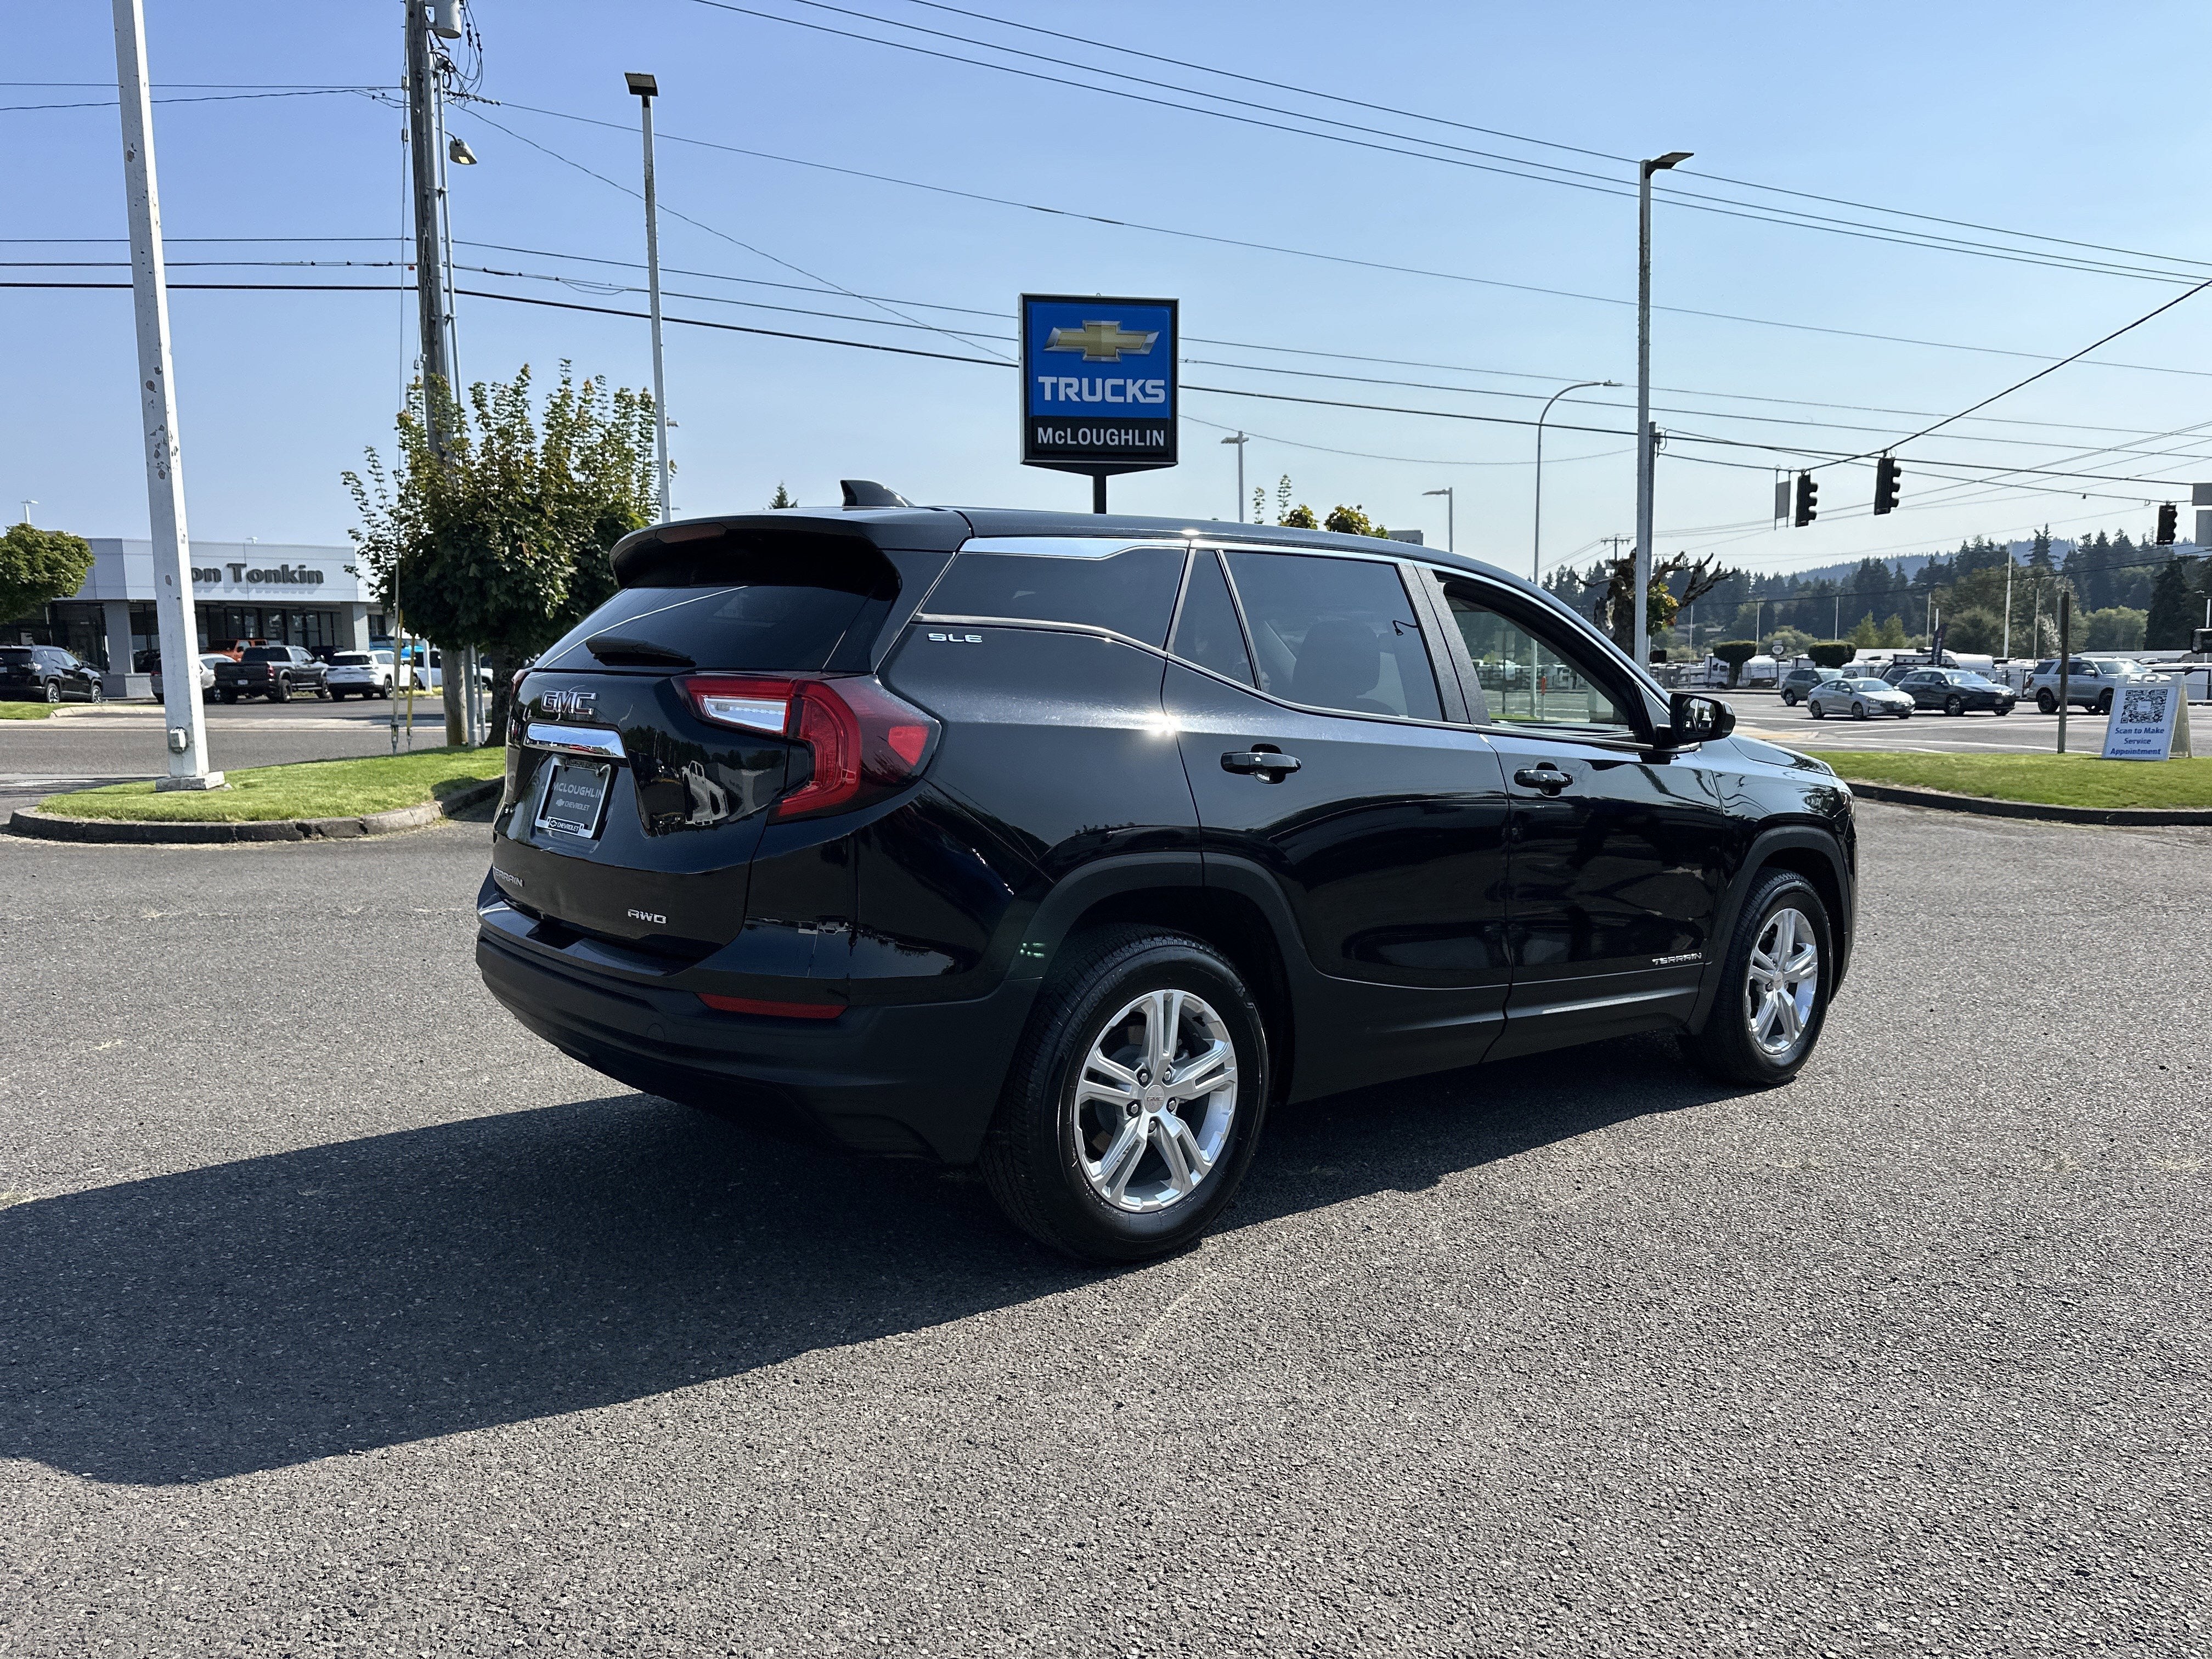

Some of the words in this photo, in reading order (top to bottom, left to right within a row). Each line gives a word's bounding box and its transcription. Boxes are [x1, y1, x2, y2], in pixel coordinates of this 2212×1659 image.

[1038, 376, 1165, 403] TRUCKS
[1037, 427, 1164, 446] McLOUGHLIN
[191, 567, 222, 582] on
[227, 563, 324, 584] Tonkin
[928, 633, 983, 643] SLE
[541, 690, 596, 715] GMC
[563, 801, 591, 812] CHEVROLET
[557, 822, 579, 832] CHEVROLET
[627, 909, 667, 924] AWD
[1652, 952, 1702, 965] TERRAIN
